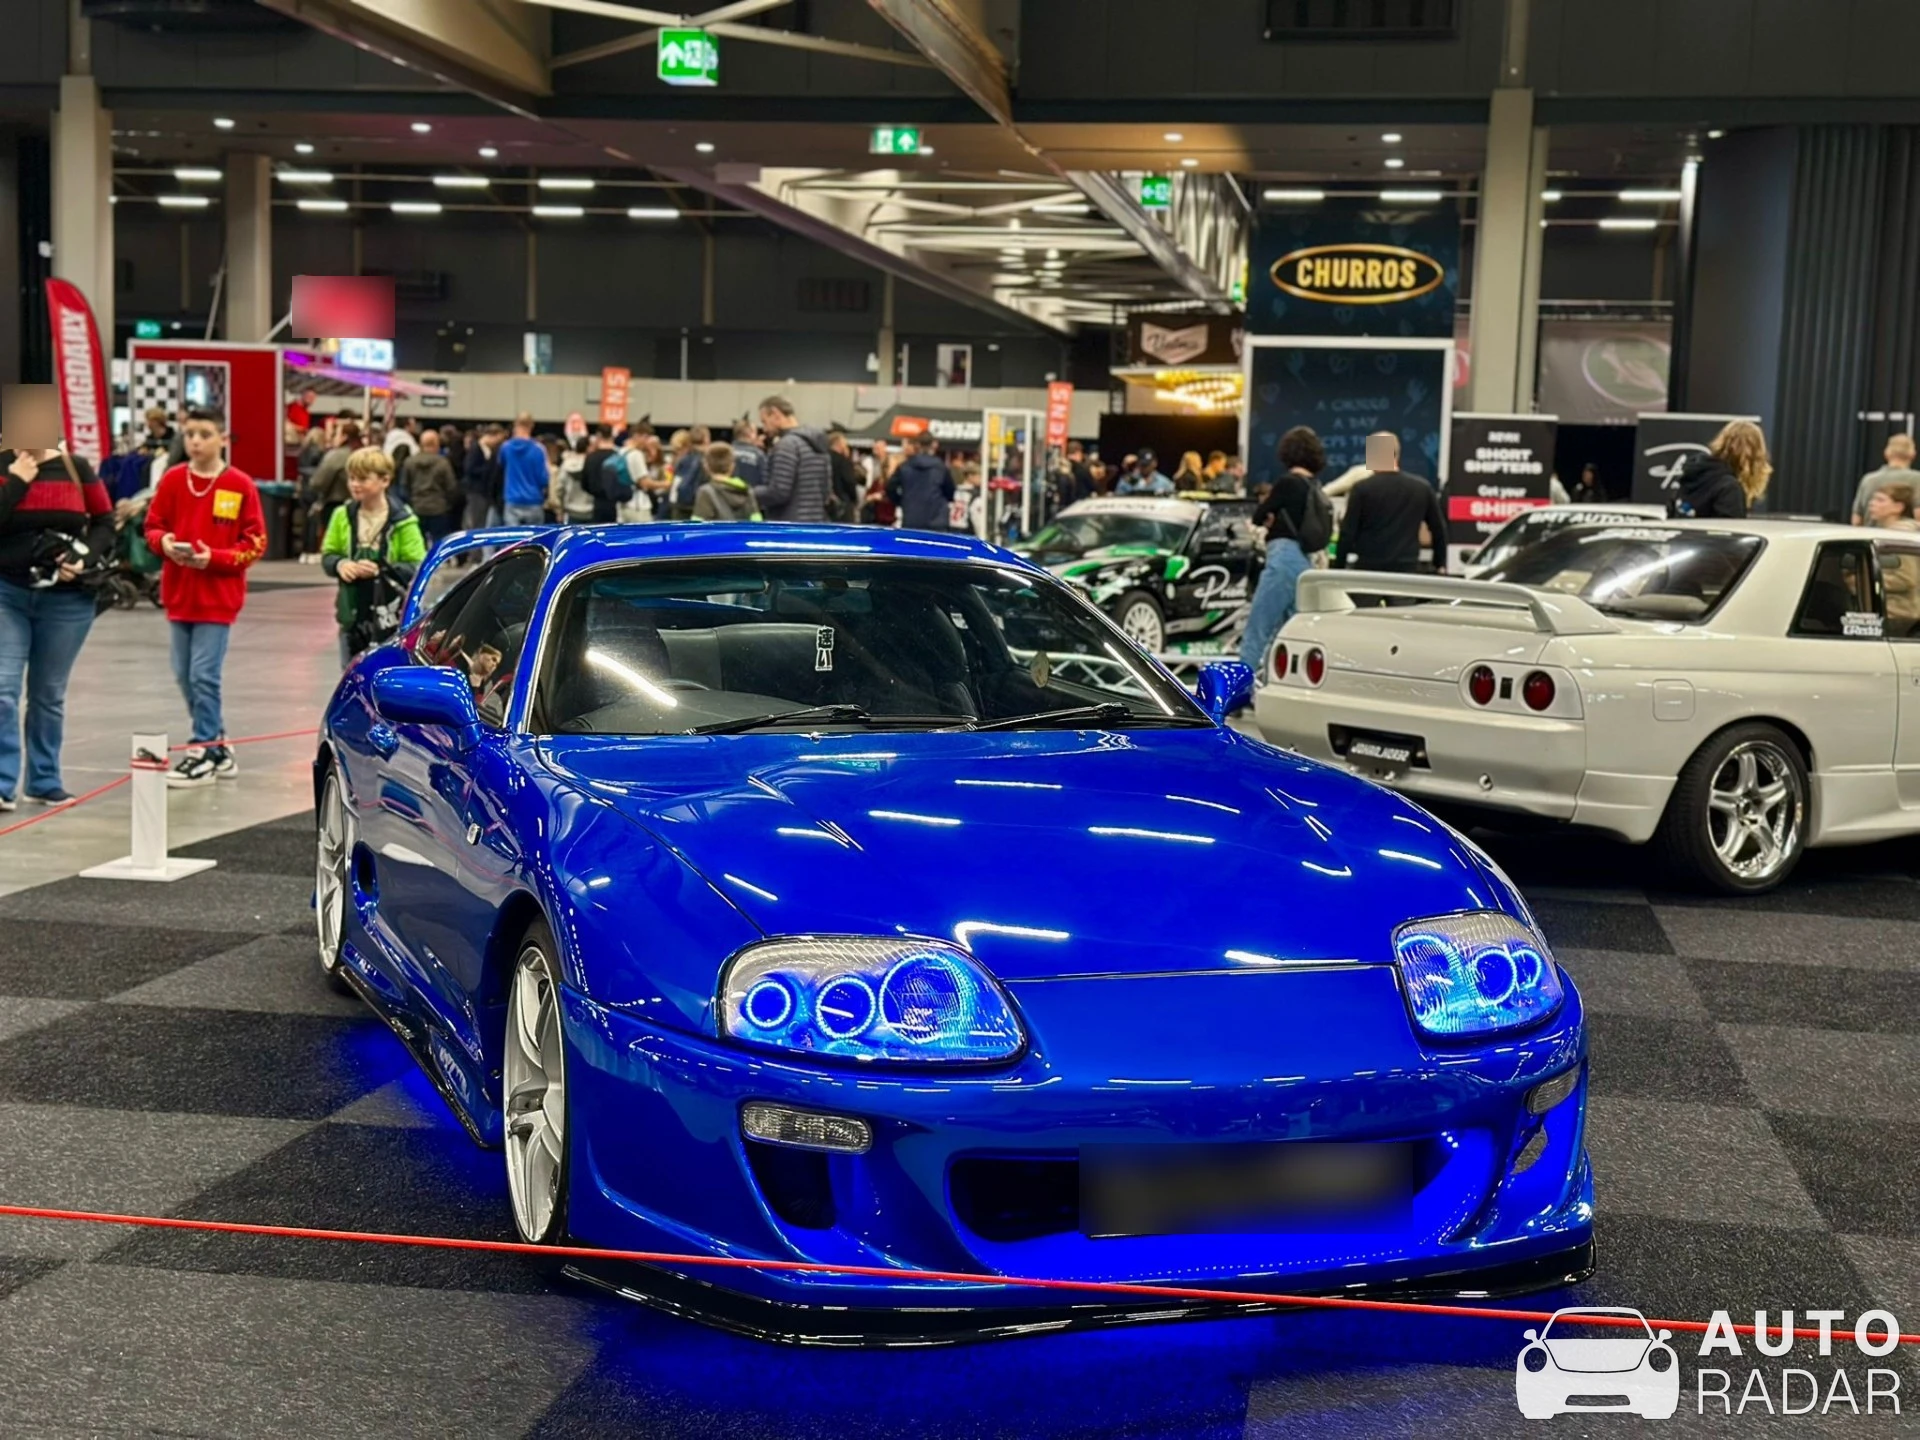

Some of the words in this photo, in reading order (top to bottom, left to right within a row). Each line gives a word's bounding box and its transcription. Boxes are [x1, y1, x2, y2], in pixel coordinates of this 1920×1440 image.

[1296, 258, 1417, 288] CHURROS
[60, 305, 101, 476] KEVAGDAILY
[1475, 447, 1533, 460] SHORT
[1464, 459, 1543, 475] SHIFTERS
